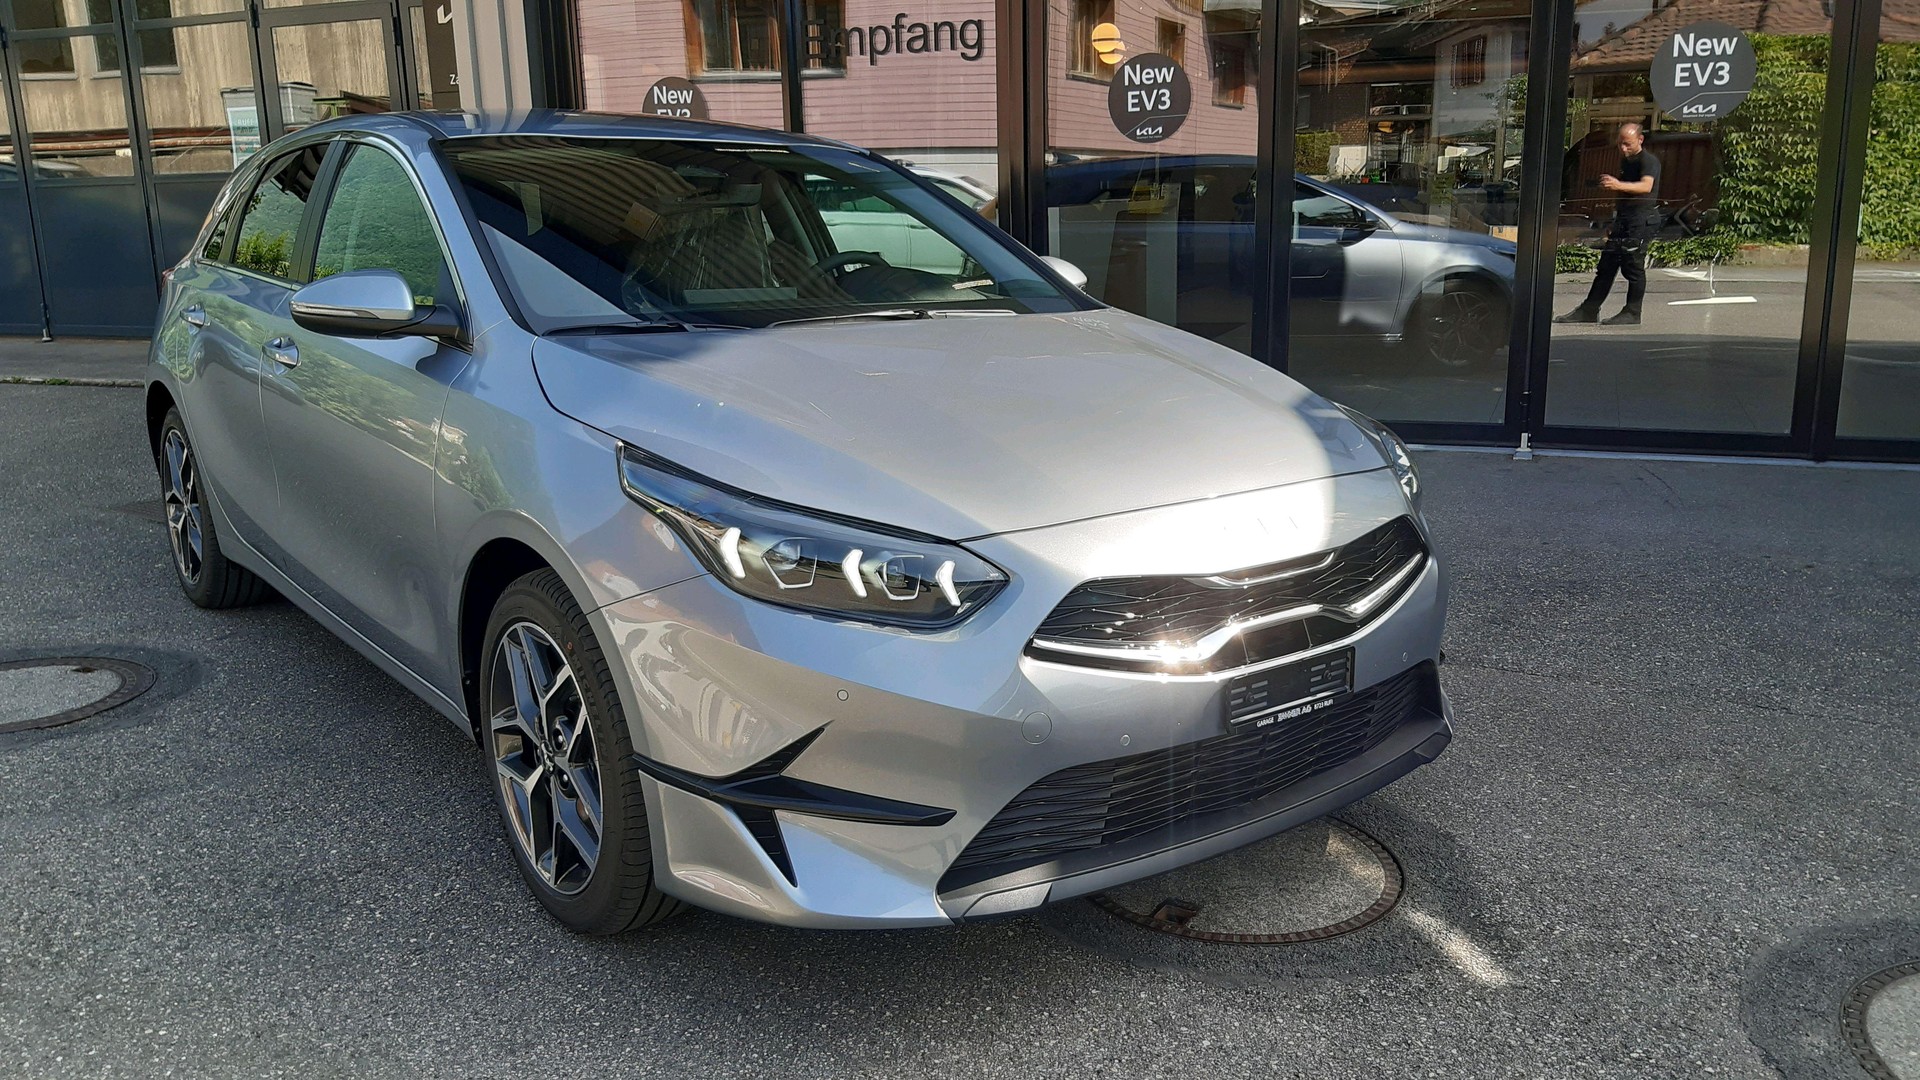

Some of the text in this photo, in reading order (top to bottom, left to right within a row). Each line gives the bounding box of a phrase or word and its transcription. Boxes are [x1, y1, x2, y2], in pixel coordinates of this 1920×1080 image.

[802, 13, 984, 66] Empfang
[1672, 32, 1739, 58] New
[1123, 63, 1175, 87] New
[1674, 61, 1731, 88] EV3
[653, 85, 694, 105] New
[1127, 88, 1172, 113] EV3
[1682, 103, 1717, 114] KIA
[1136, 126, 1163, 136] KIA
